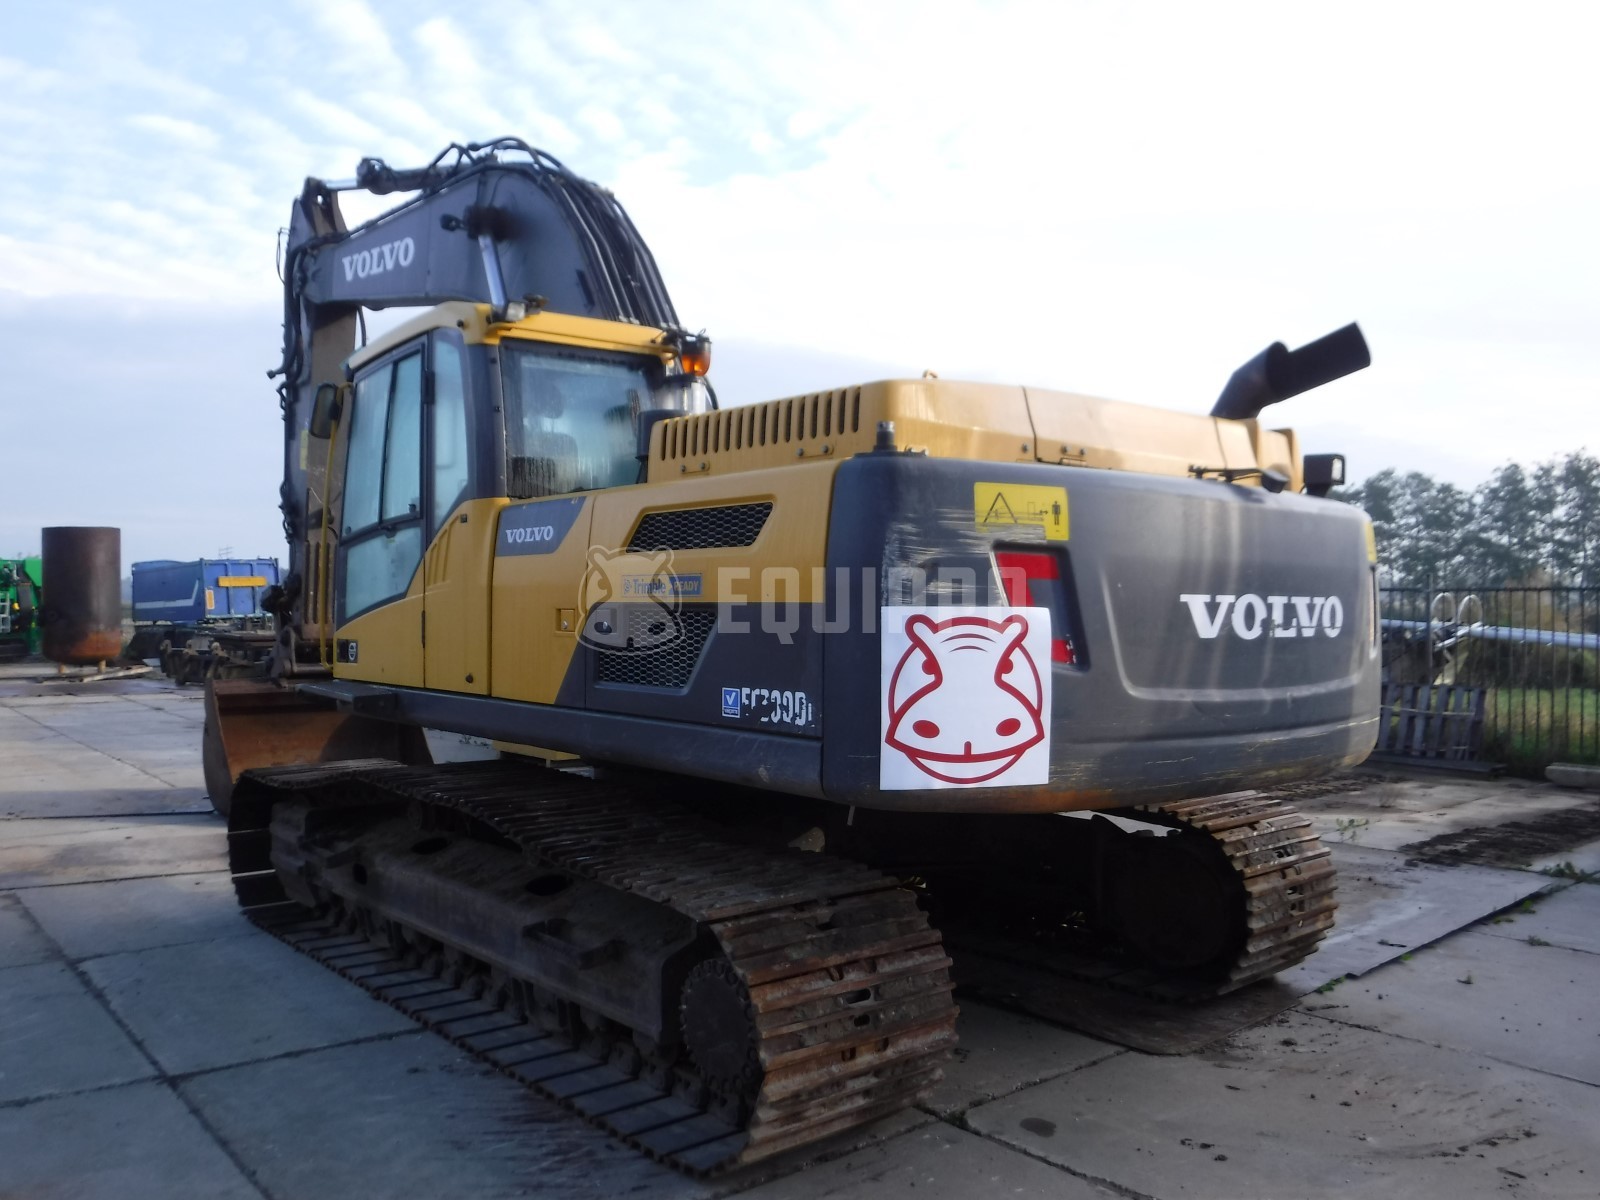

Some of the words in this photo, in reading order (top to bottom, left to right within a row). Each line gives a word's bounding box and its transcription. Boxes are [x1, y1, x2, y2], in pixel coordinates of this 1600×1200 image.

[342, 237, 415, 281] VOLVO
[506, 526, 554, 543] VOLVO
[633, 579, 666, 594] Trimble
[674, 581, 699, 591] READY
[1180, 593, 1343, 640] VOLVO
